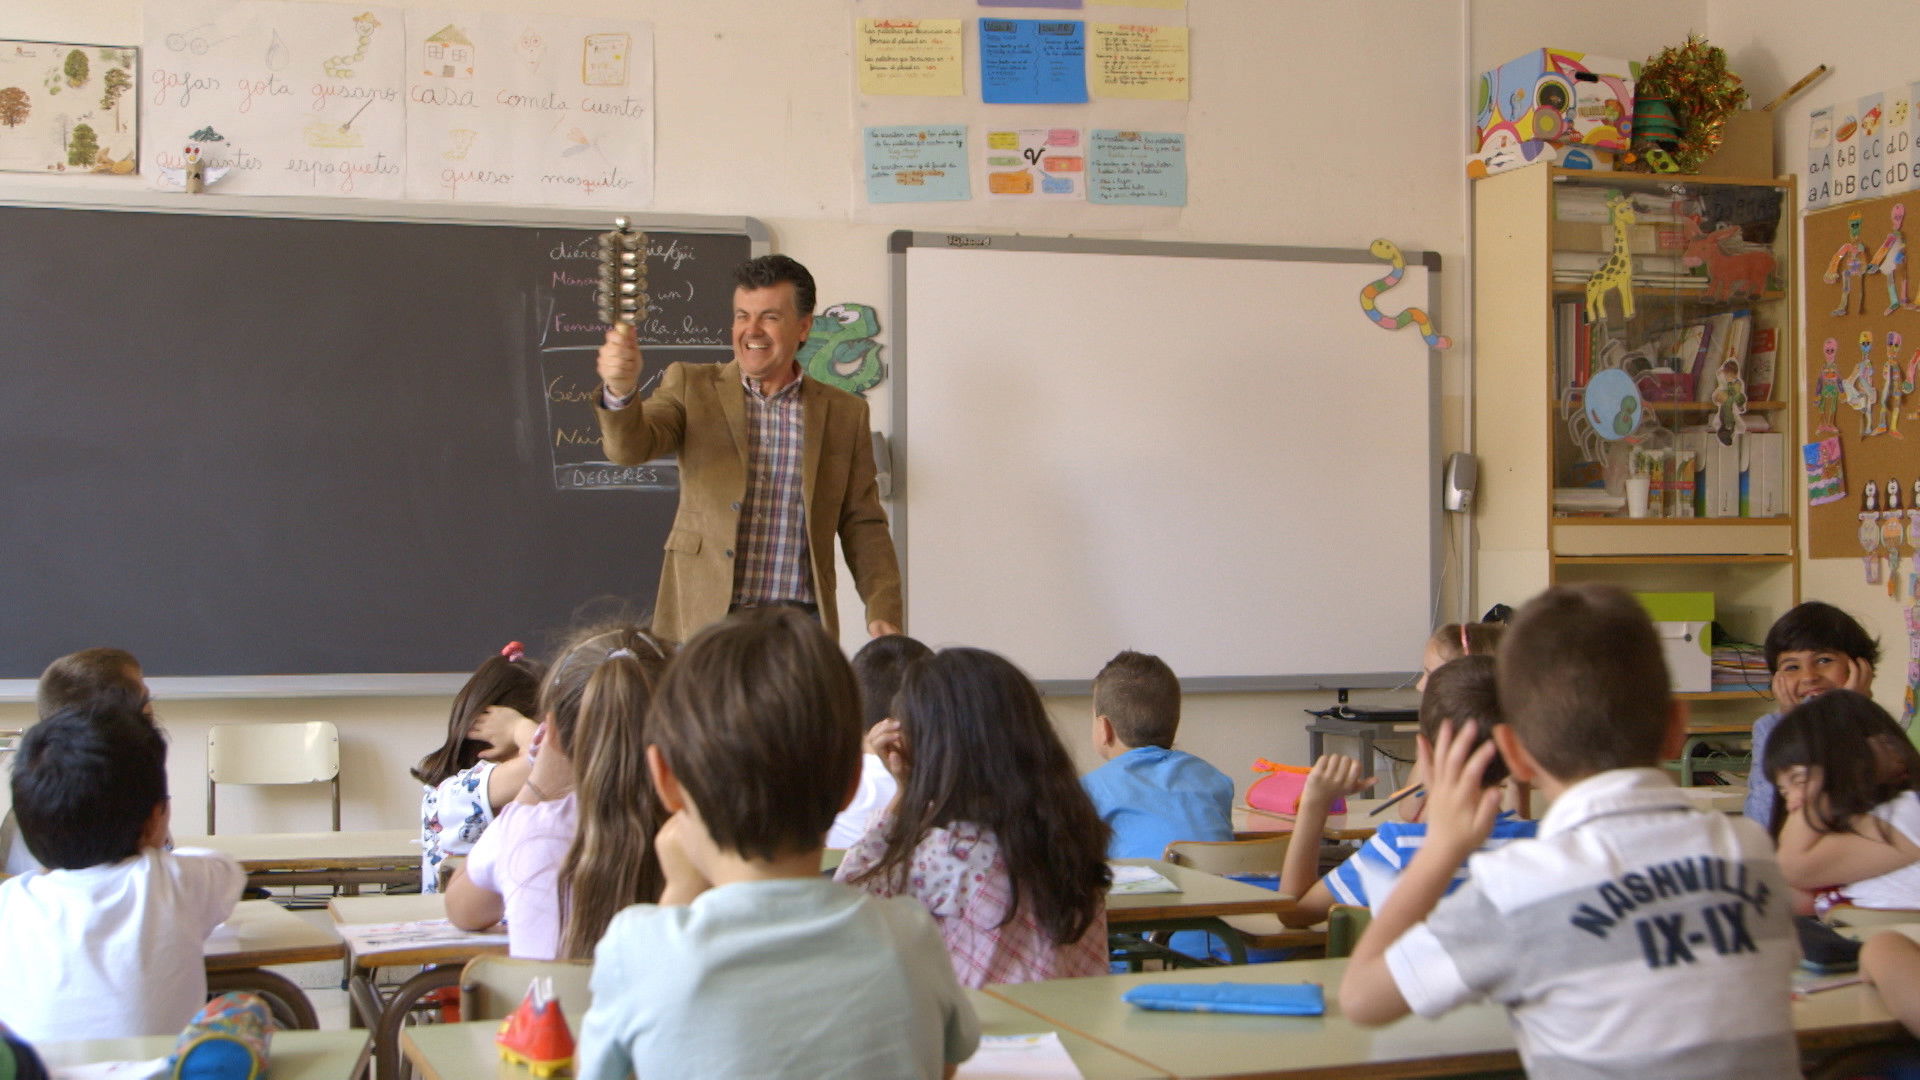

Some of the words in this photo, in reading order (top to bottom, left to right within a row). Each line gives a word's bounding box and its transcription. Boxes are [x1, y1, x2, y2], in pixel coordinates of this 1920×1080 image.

[151, 69, 221, 108] gafas
[238, 73, 296, 113] gota
[311, 83, 400, 111] gusano
[1637, 902, 1759, 969] IX-IX
